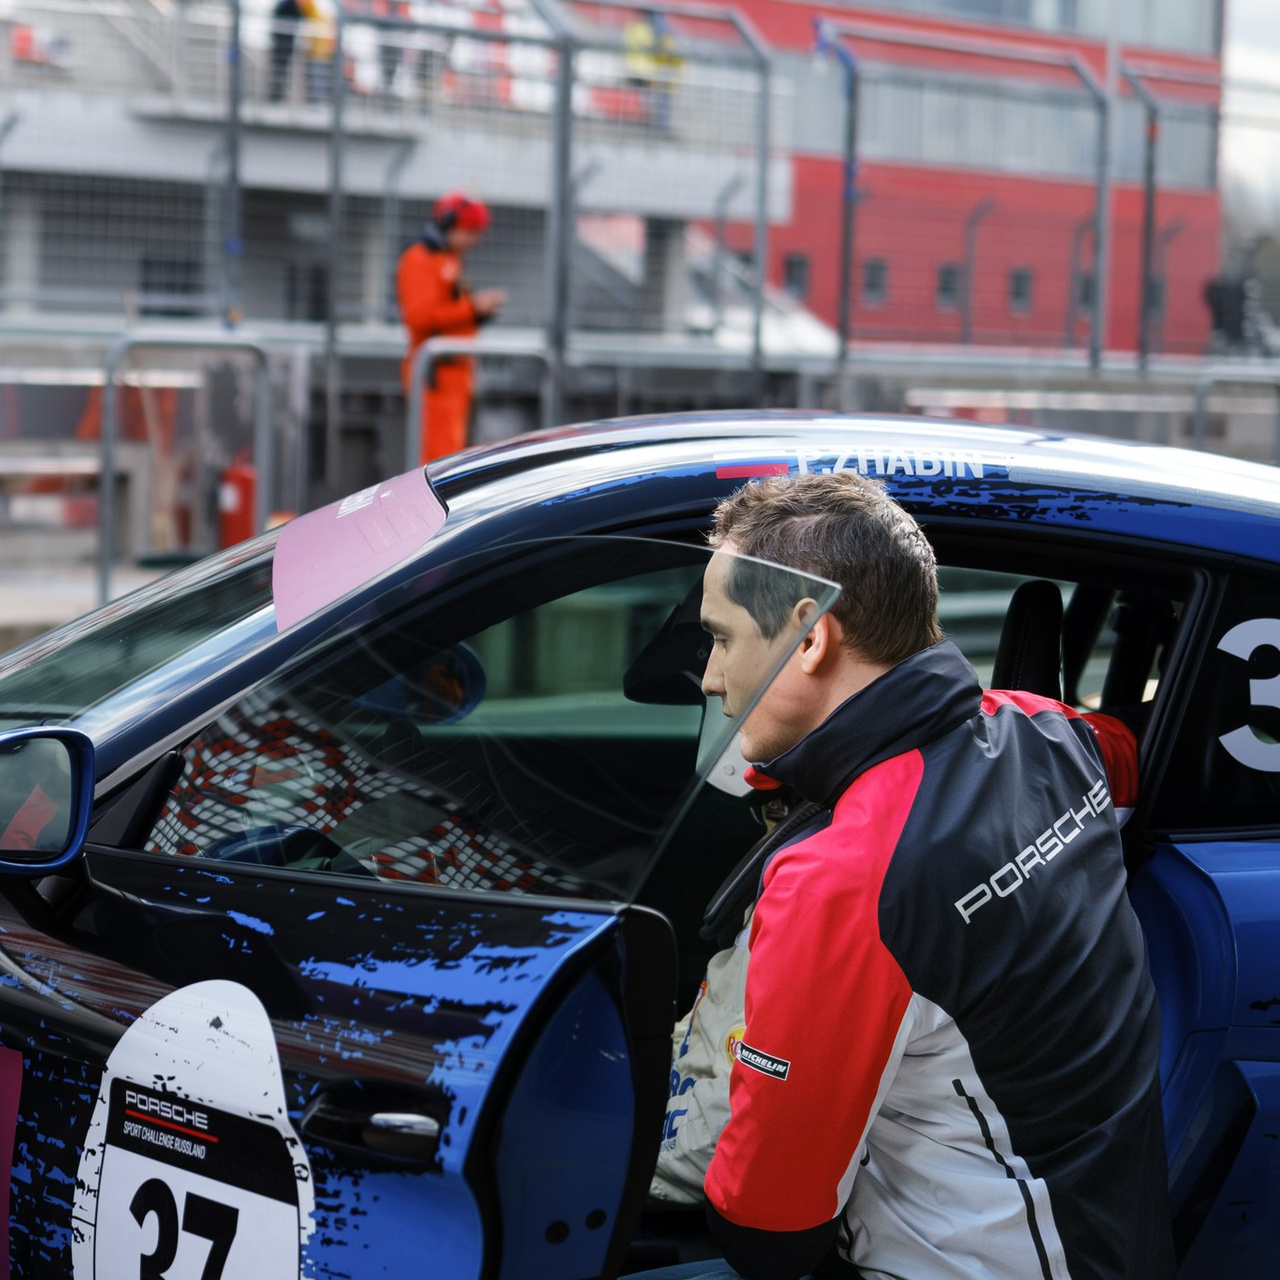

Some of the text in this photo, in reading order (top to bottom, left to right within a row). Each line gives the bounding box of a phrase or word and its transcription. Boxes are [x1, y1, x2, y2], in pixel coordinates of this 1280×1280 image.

[1217, 617, 1280, 773] 3
[954, 778, 1112, 925] PORSCHE
[740, 1048, 787, 1073] MICHELIN
[125, 1089, 208, 1130] PORSCHE
[123, 1121, 206, 1159] SPORT CHALLENGE RUSSLAND
